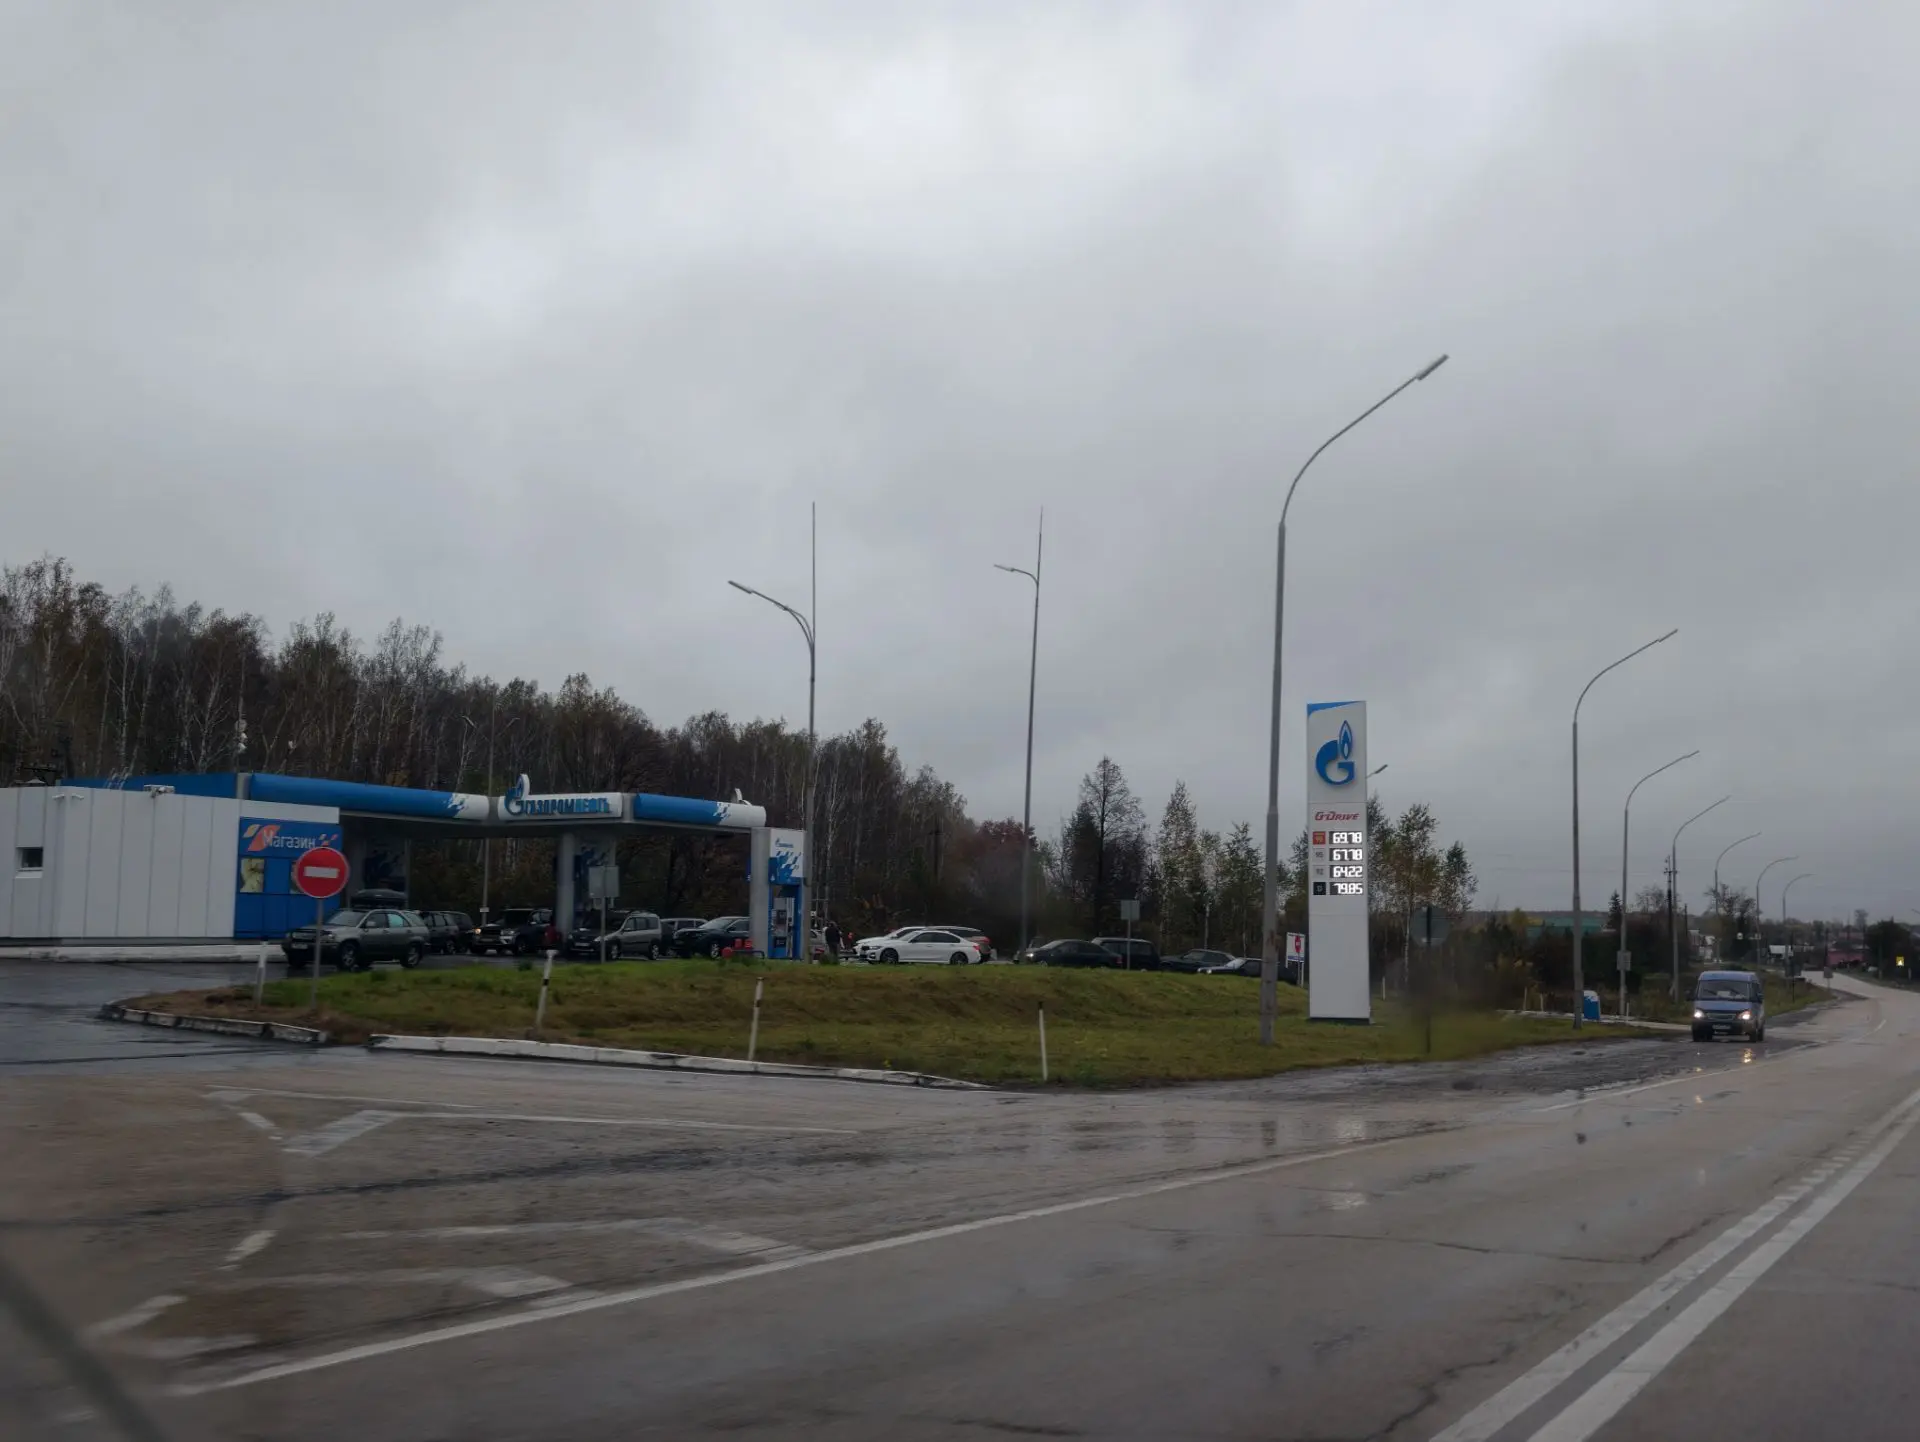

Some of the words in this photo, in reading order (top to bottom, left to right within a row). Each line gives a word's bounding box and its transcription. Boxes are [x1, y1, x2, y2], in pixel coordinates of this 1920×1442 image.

[264, 829, 316, 848] Магазин
[1333, 832, 1362, 843] 69.78
[1333, 849, 1363, 860] 67.78
[1333, 883, 1363, 894] 79.85
